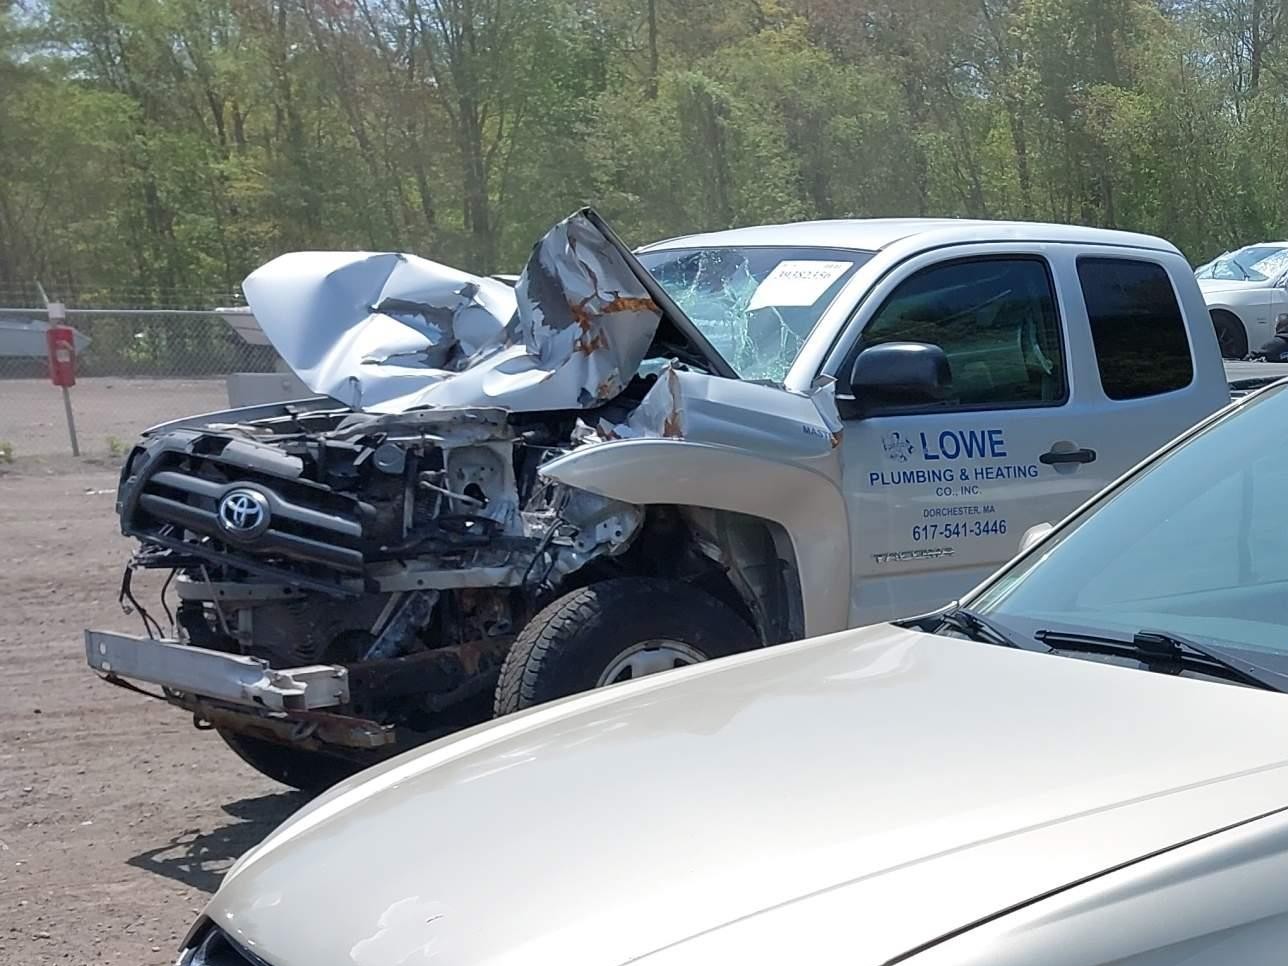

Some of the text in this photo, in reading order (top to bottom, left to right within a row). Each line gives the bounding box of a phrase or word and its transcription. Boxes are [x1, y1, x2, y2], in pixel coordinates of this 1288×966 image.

[919, 429, 1008, 461] LOWE
[869, 464, 1039, 486] PLUMBING & HEATING
[960, 485, 983, 496] INC.
[982, 504, 996, 514] MA
[912, 519, 1007, 541] 617-541-3446
